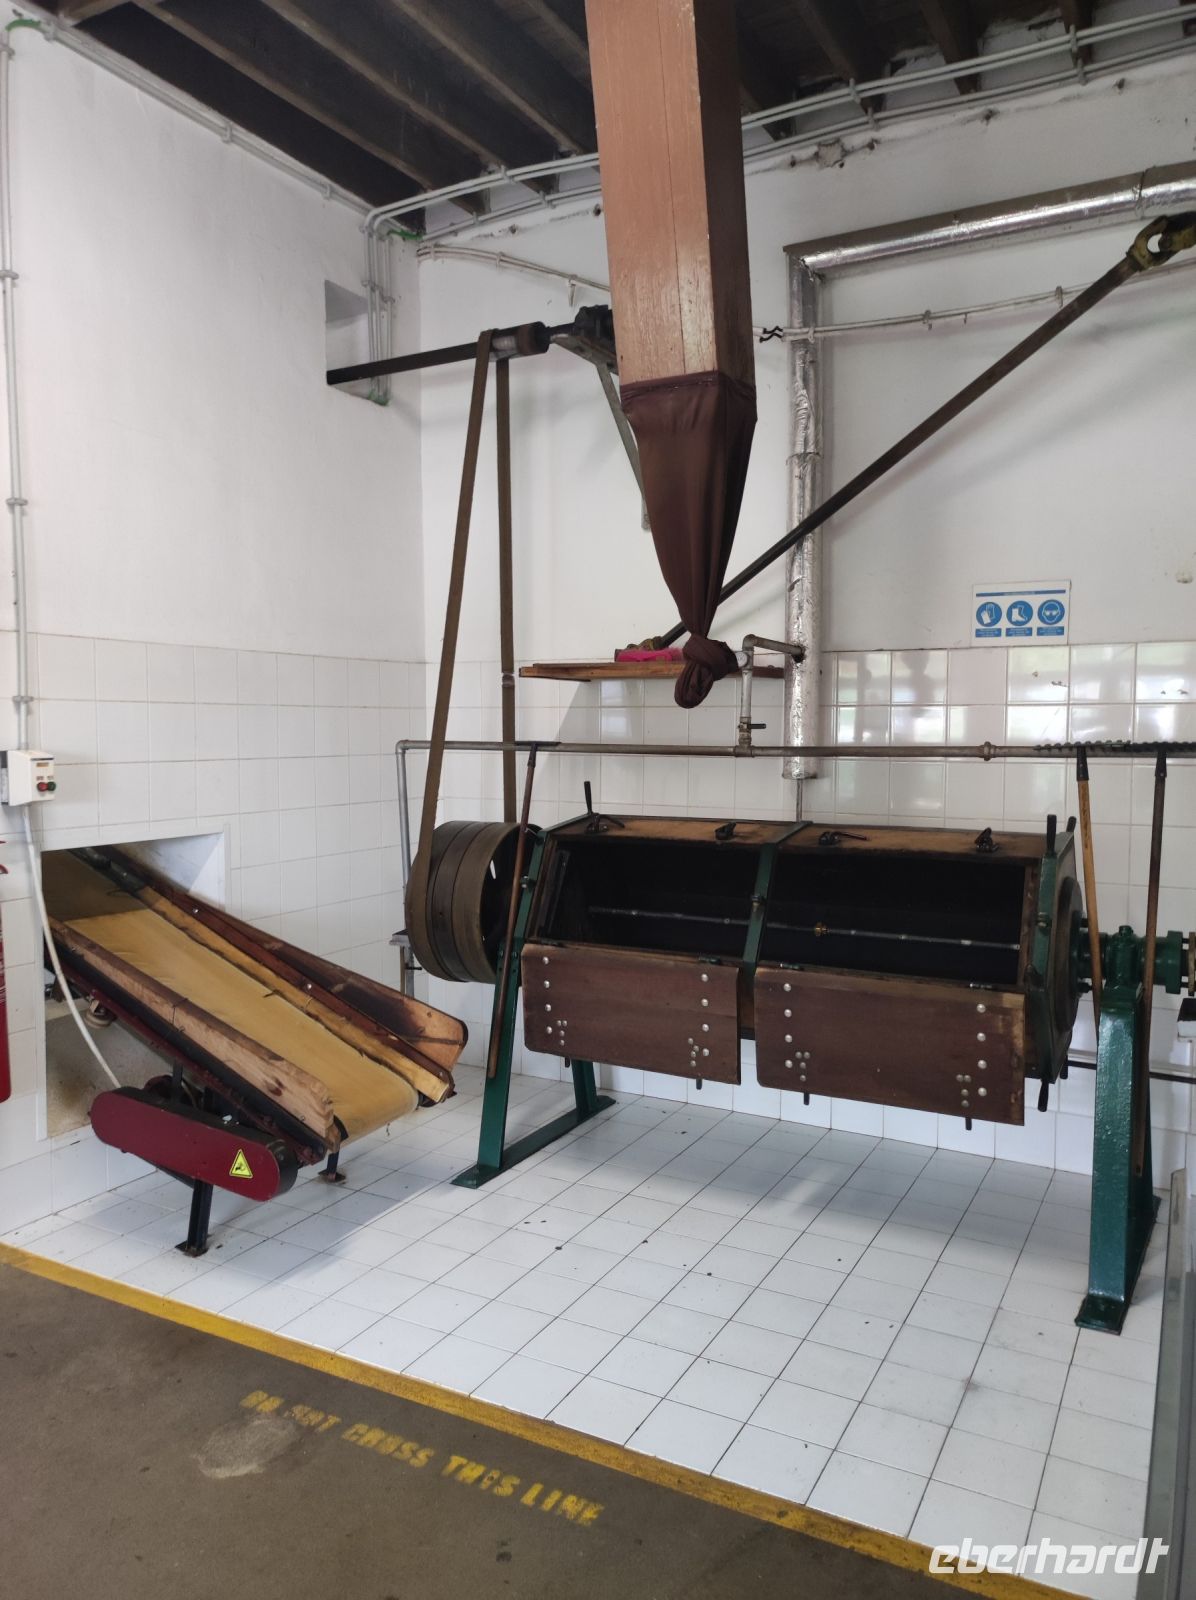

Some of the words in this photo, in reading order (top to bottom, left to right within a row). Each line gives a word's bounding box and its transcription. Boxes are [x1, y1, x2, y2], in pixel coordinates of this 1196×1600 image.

[342, 1423, 435, 1467] CROSS
[442, 1455, 520, 1496] THIS
[520, 1483, 604, 1525] LINE
